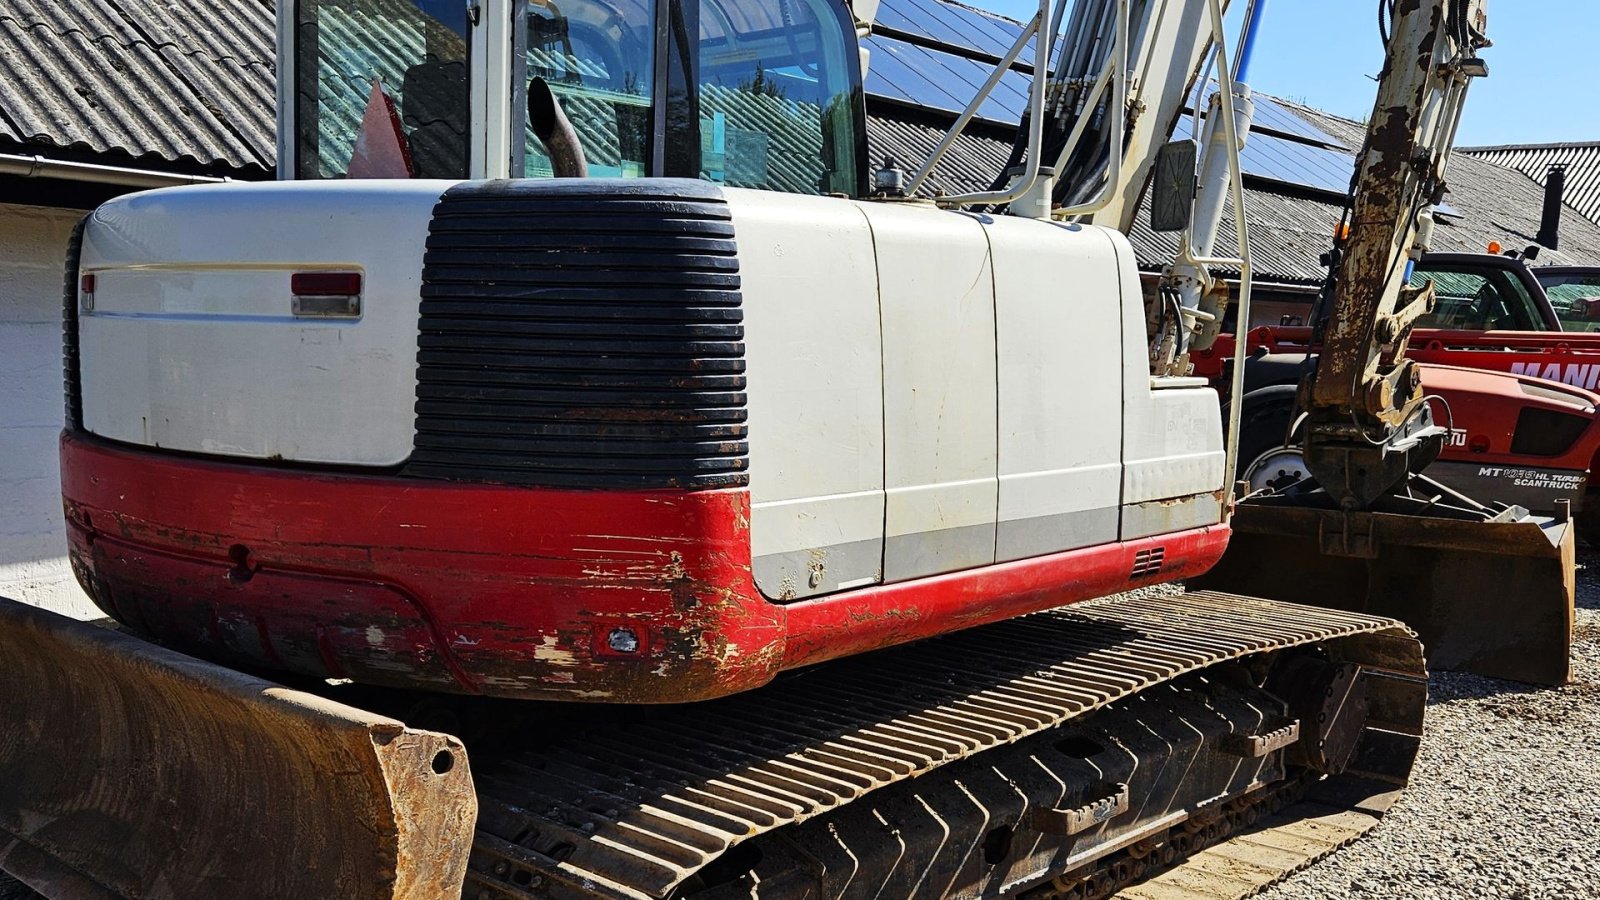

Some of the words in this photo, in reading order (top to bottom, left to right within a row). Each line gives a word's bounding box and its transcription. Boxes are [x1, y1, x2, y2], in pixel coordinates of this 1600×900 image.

[1510, 362, 1600, 389] MANI
[1478, 467, 1503, 477] MT
[1535, 473, 1549, 481] HL
[1552, 474, 1587, 483] TURBO
[1514, 478, 1579, 490] SCANTRUCK
